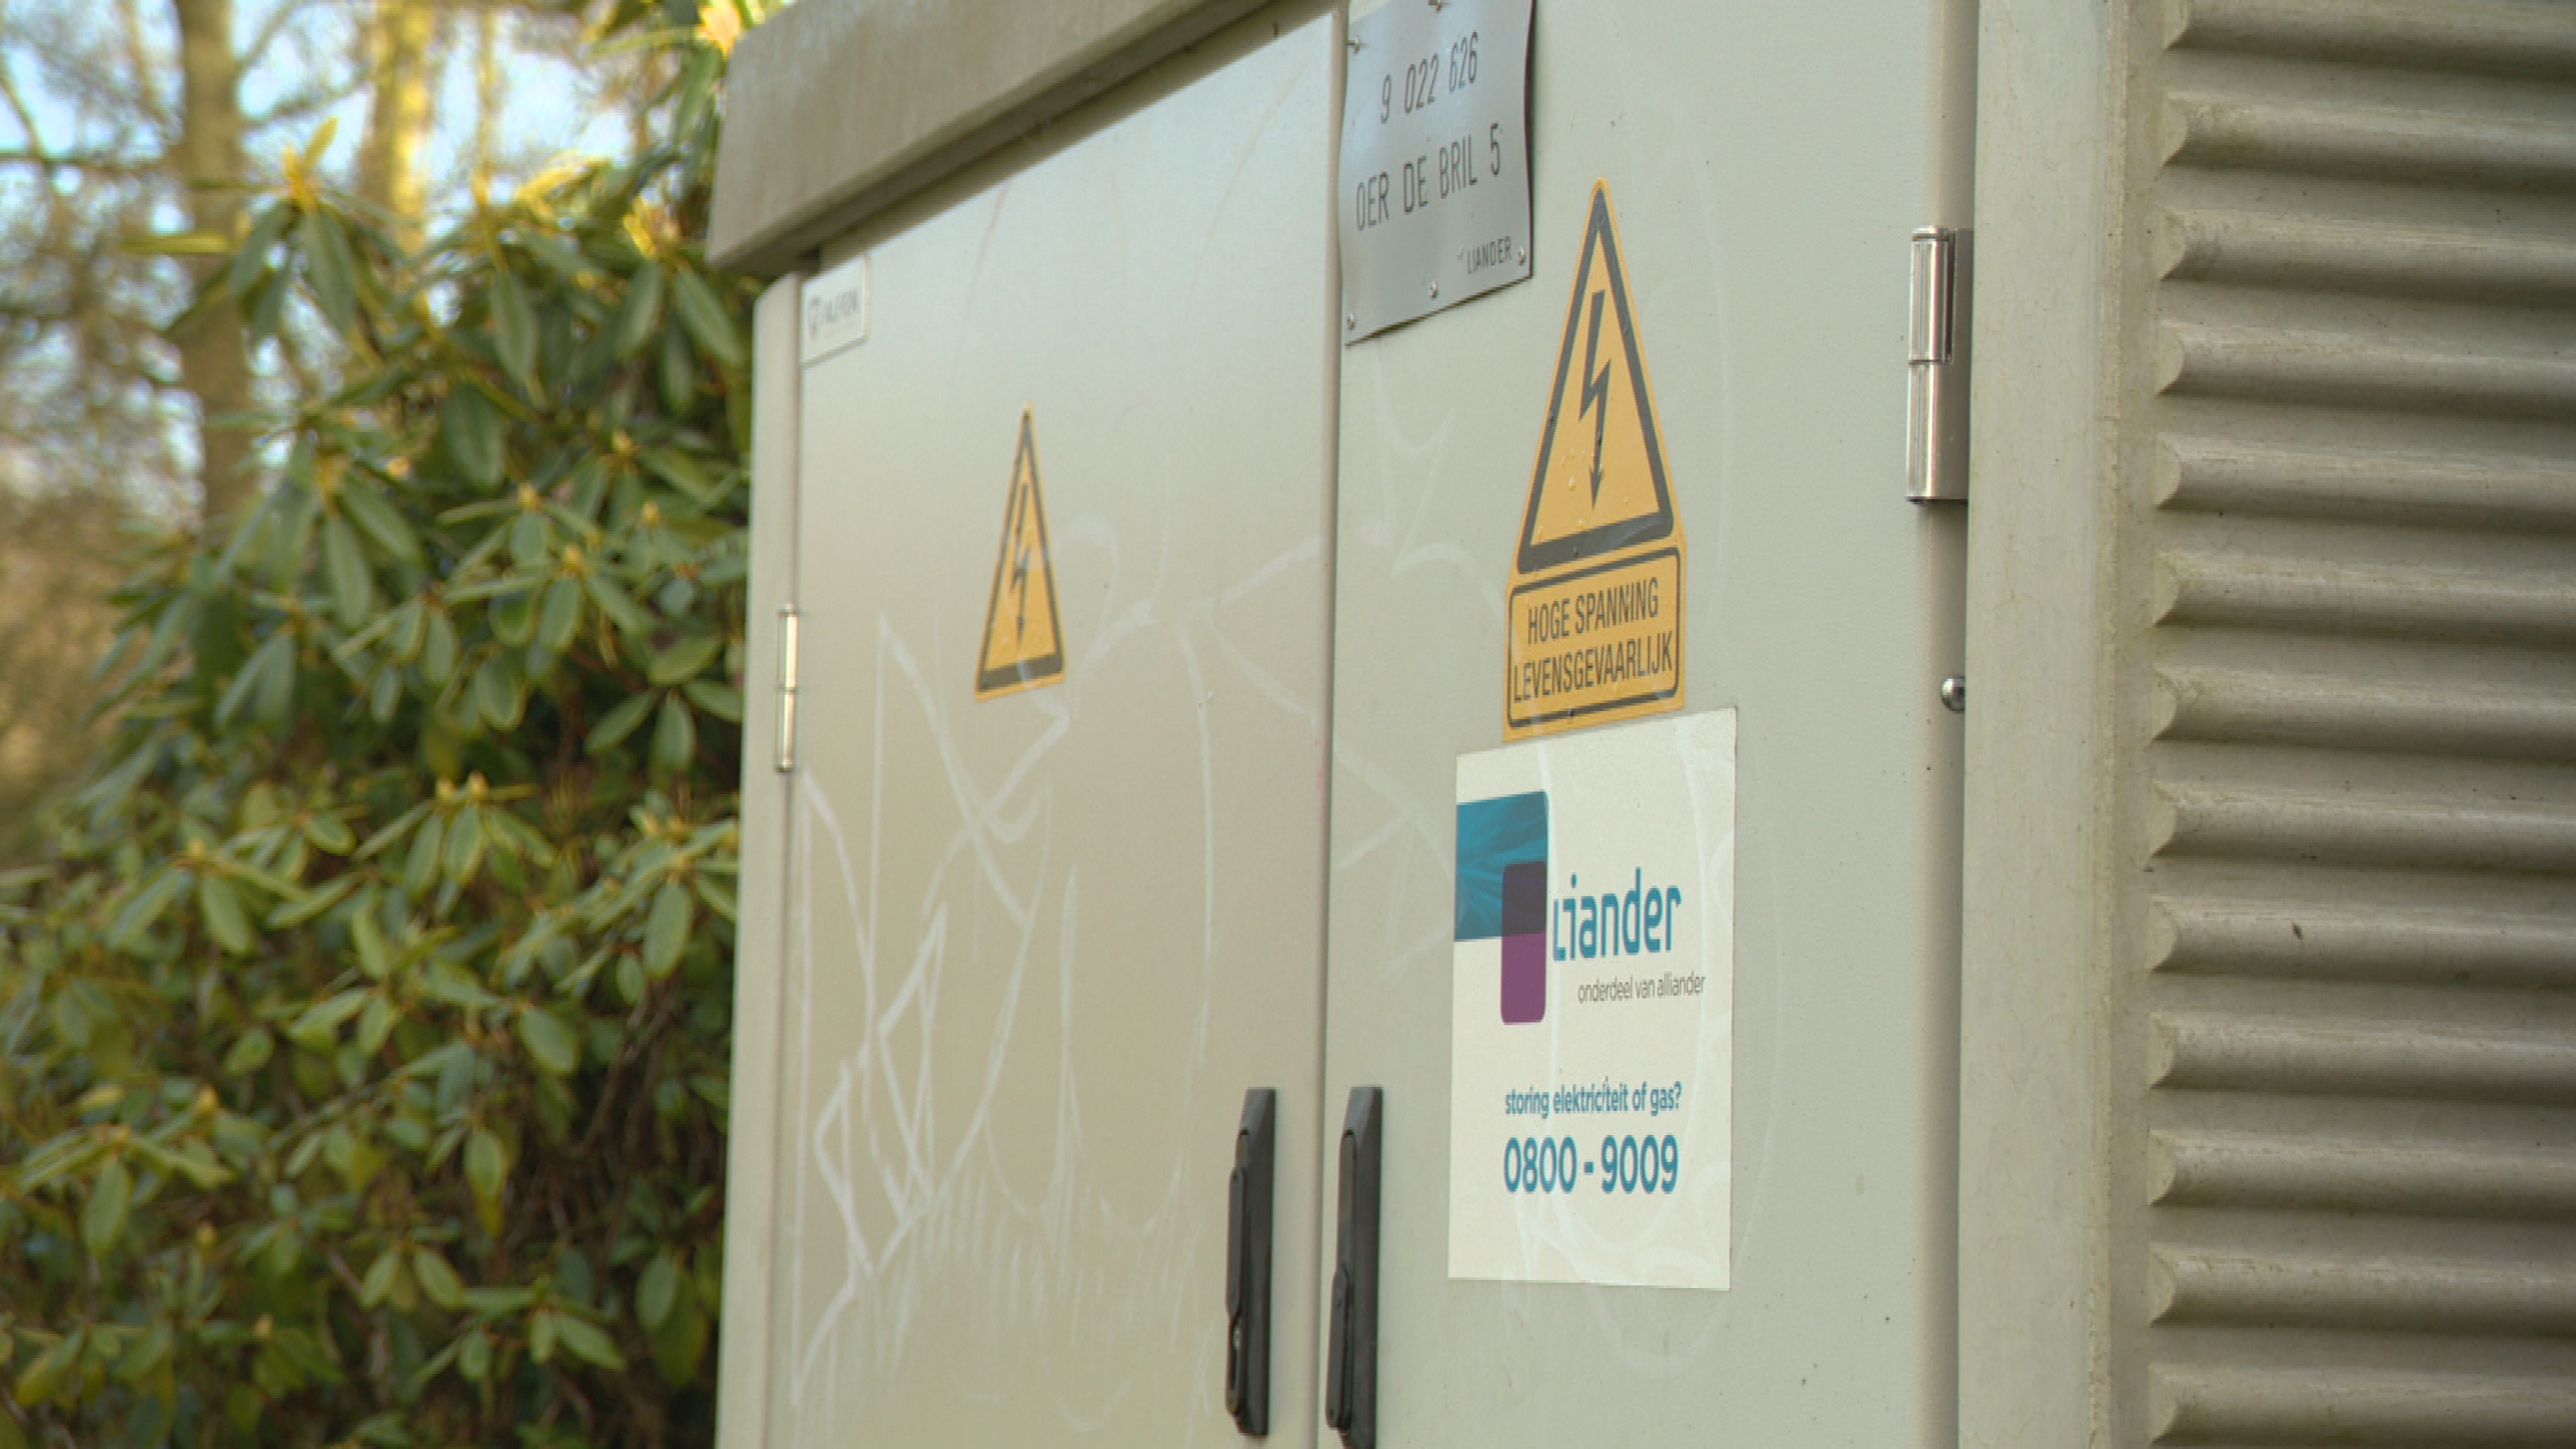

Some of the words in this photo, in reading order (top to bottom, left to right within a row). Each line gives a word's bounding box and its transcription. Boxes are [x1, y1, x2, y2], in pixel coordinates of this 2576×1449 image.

[1381, 74, 1392, 123] 9
[1404, 54, 1440, 113] 022
[1448, 31, 1479, 93] 626
[1403, 156, 1428, 214] DE
[1440, 135, 1478, 199] BRIL
[1490, 123, 1501, 177] 5
[1467, 236, 1512, 274] LIANDER
[1527, 598, 1570, 645] HOGE
[1574, 576, 1658, 634] SPANNING
[1513, 630, 1673, 703] LEVENSGEVAARLIJK
[1552, 866, 1682, 961] Liander
[1577, 976, 1633, 1004] onderdeel
[1635, 978, 1656, 1000] van
[1656, 970, 1706, 998] alliander
[1505, 1086, 1550, 1119] storing
[1553, 1081, 1629, 1114] elektriciteit
[1632, 1081, 1647, 1112] of
[1650, 1080, 1682, 1117] gas?
[1504, 1136, 1578, 1195] 0800
[1601, 1134, 1678, 1195] 9009
